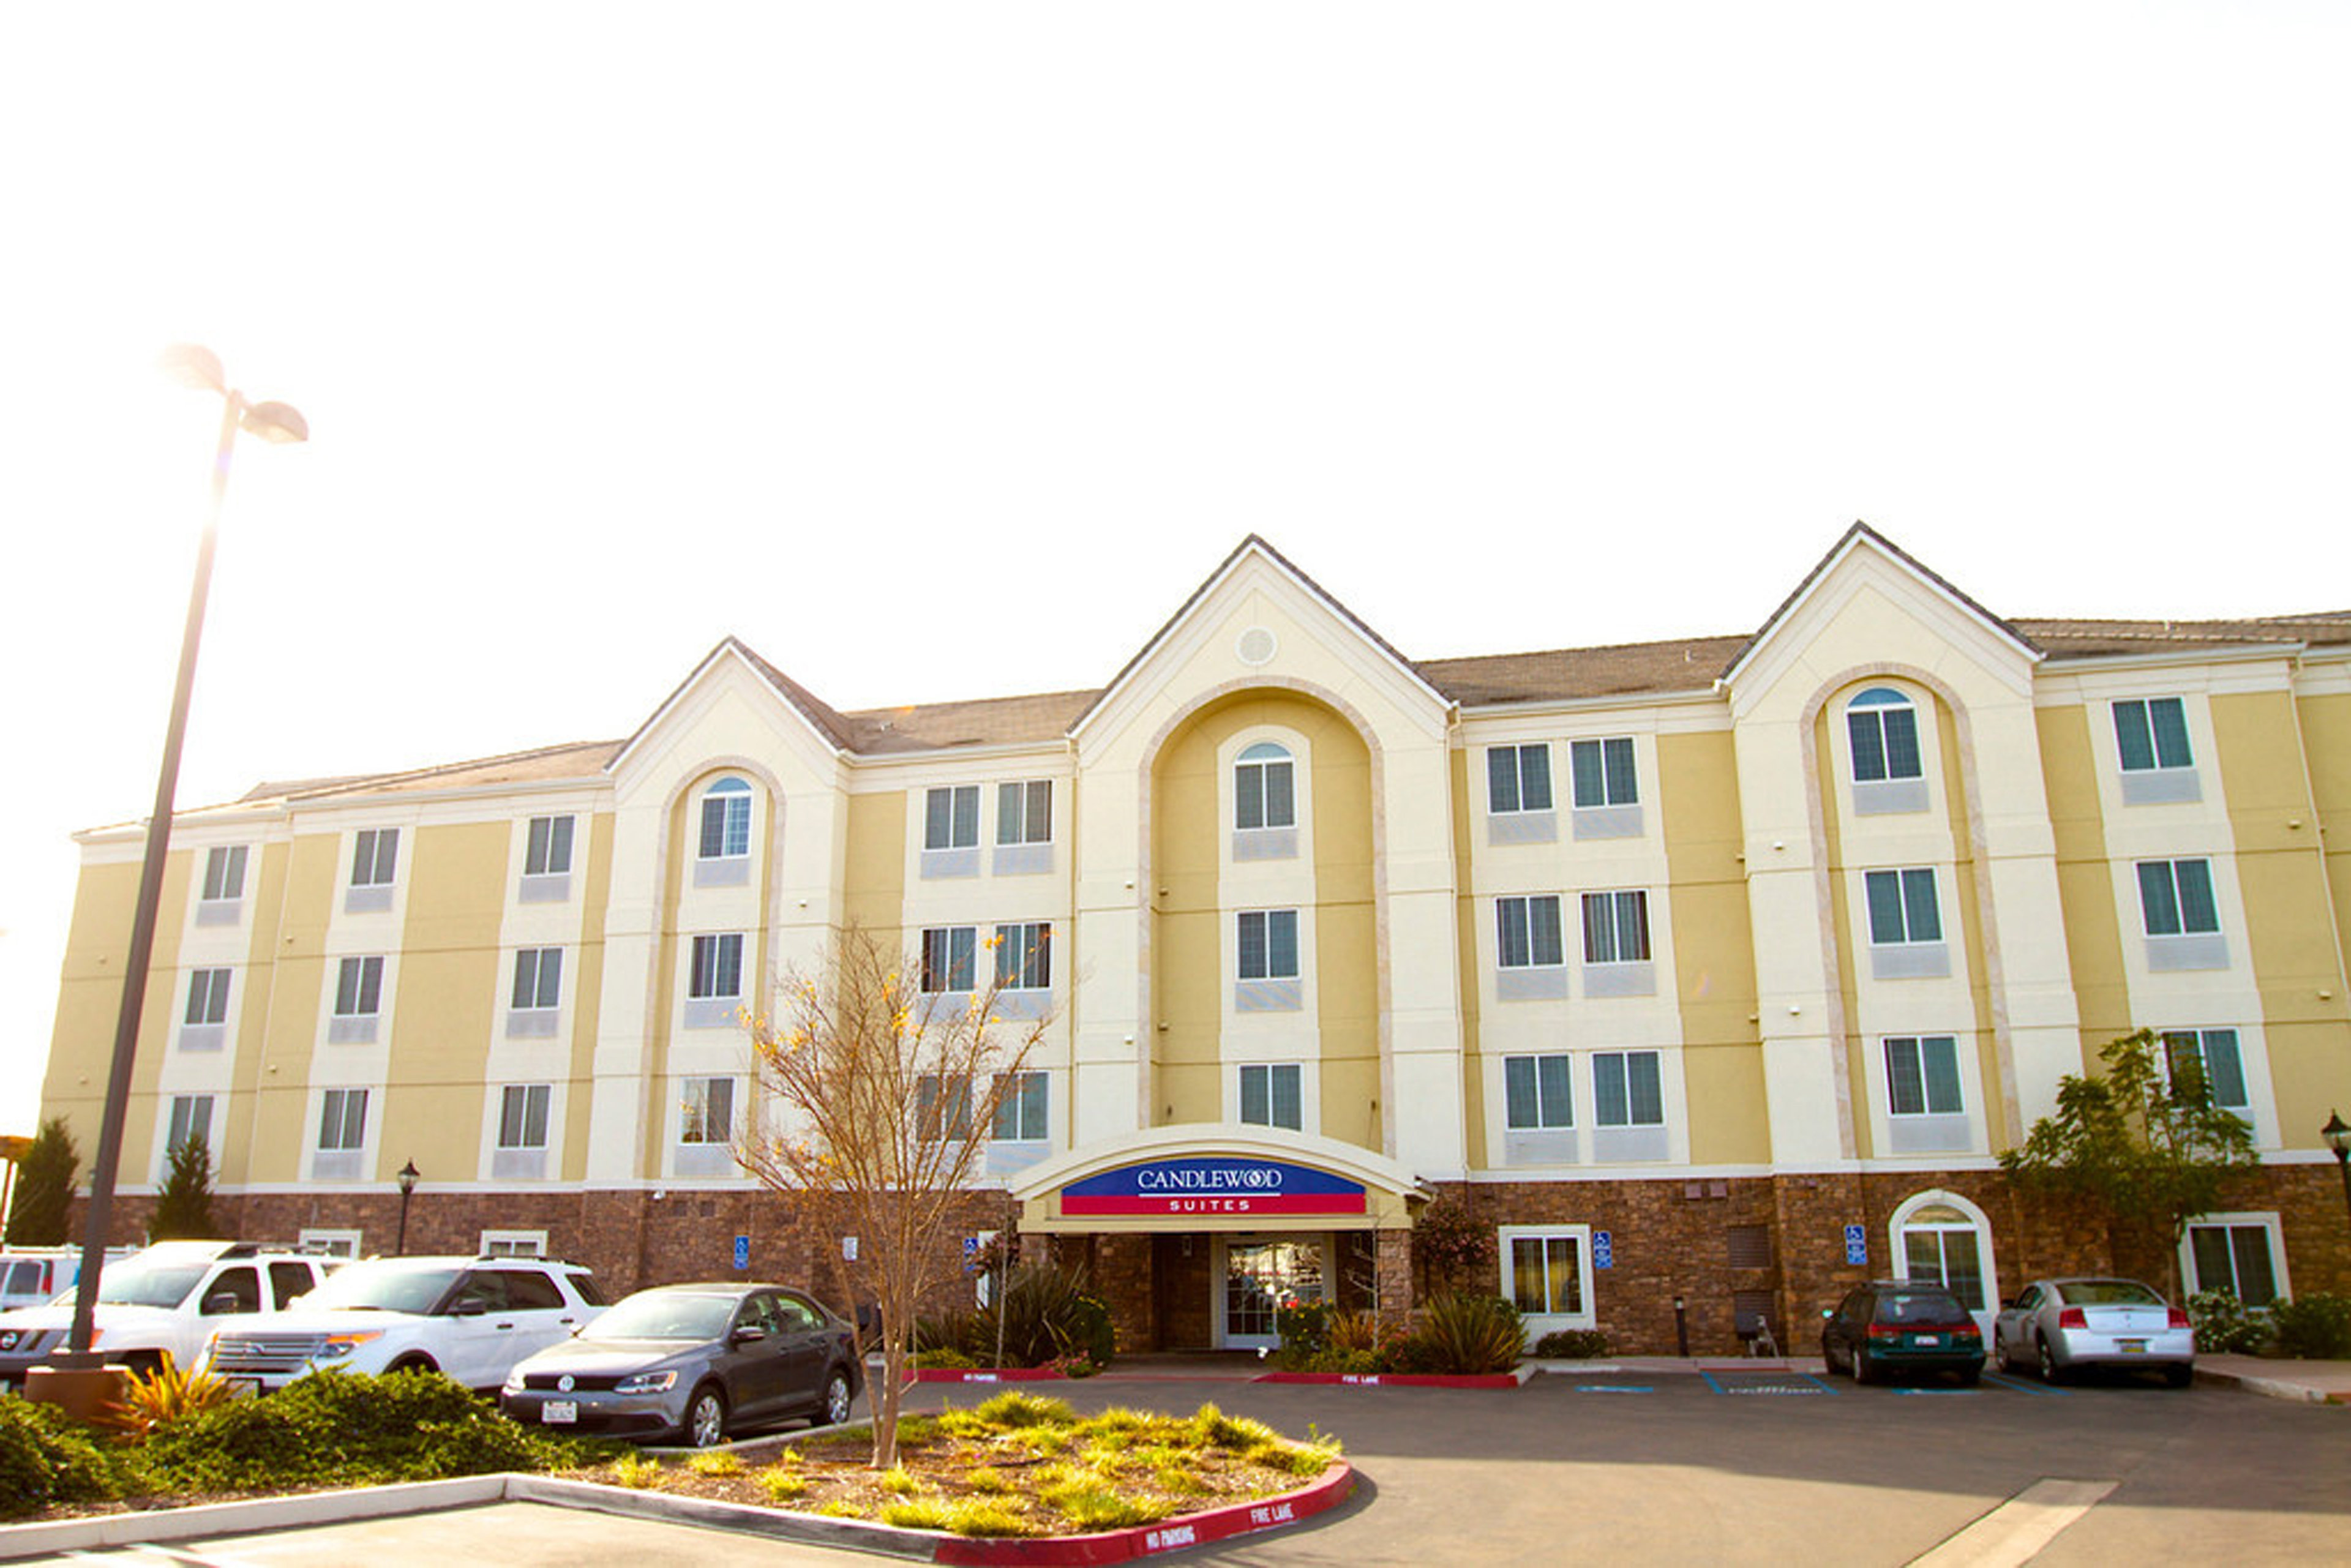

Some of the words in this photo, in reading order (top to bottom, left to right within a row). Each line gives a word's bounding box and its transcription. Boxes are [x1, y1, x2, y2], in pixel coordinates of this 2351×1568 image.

[1138, 1169, 1282, 1188] CANDLEWOOD
[1170, 1200, 1250, 1211] SUITES
[1251, 1507, 1270, 1523] FIRE
[1272, 1503, 1294, 1521] LANE
[1146, 1532, 1160, 1549] NO
